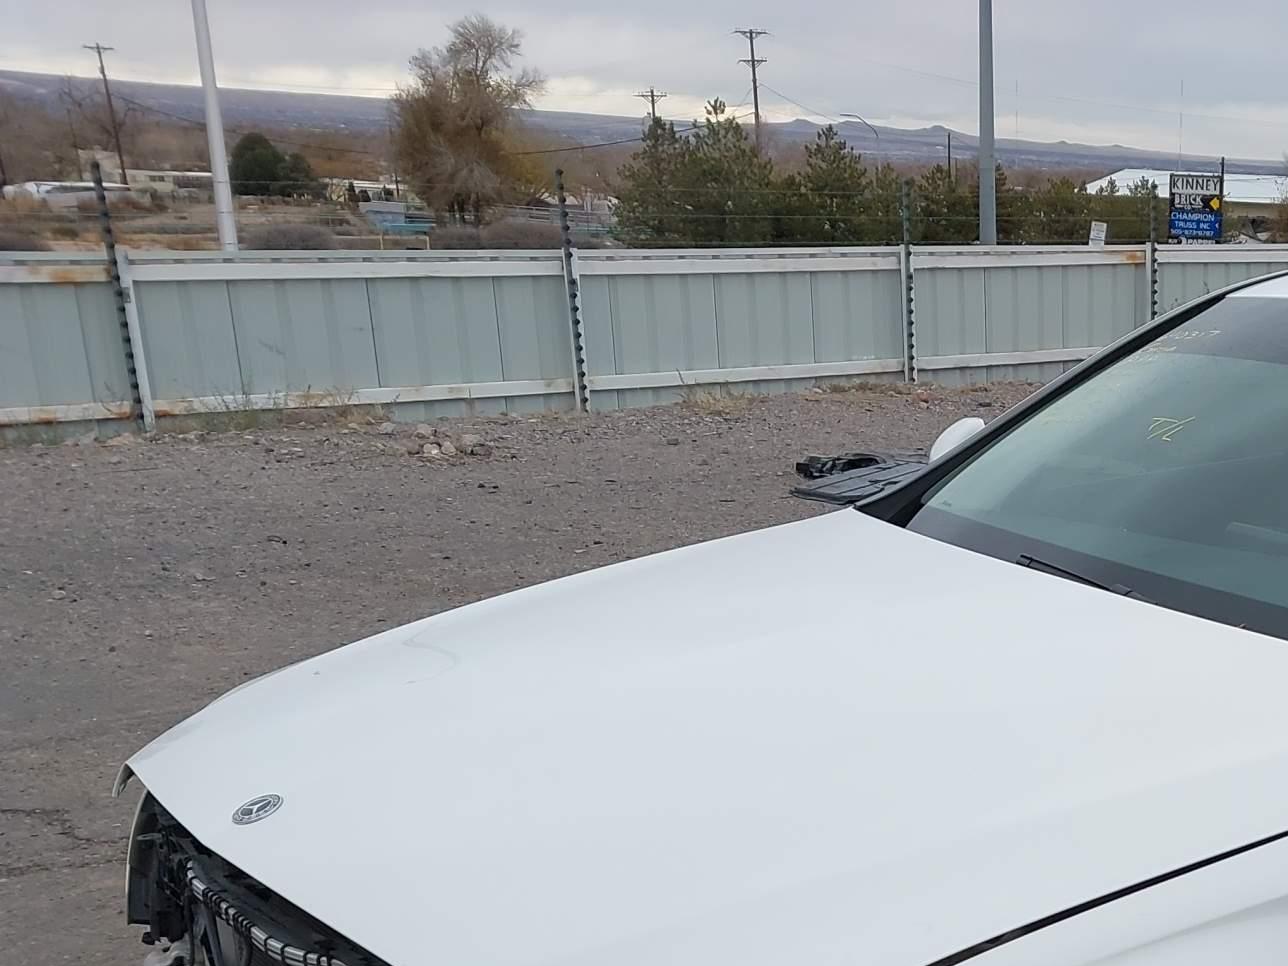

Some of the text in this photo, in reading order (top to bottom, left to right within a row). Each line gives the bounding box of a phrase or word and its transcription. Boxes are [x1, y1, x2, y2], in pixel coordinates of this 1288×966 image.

[1172, 177, 1220, 191] KINNEY
[1174, 193, 1203, 205] BRICK
[1171, 211, 1215, 221] CHAMPION
[1175, 220, 1197, 229] TRUSS
